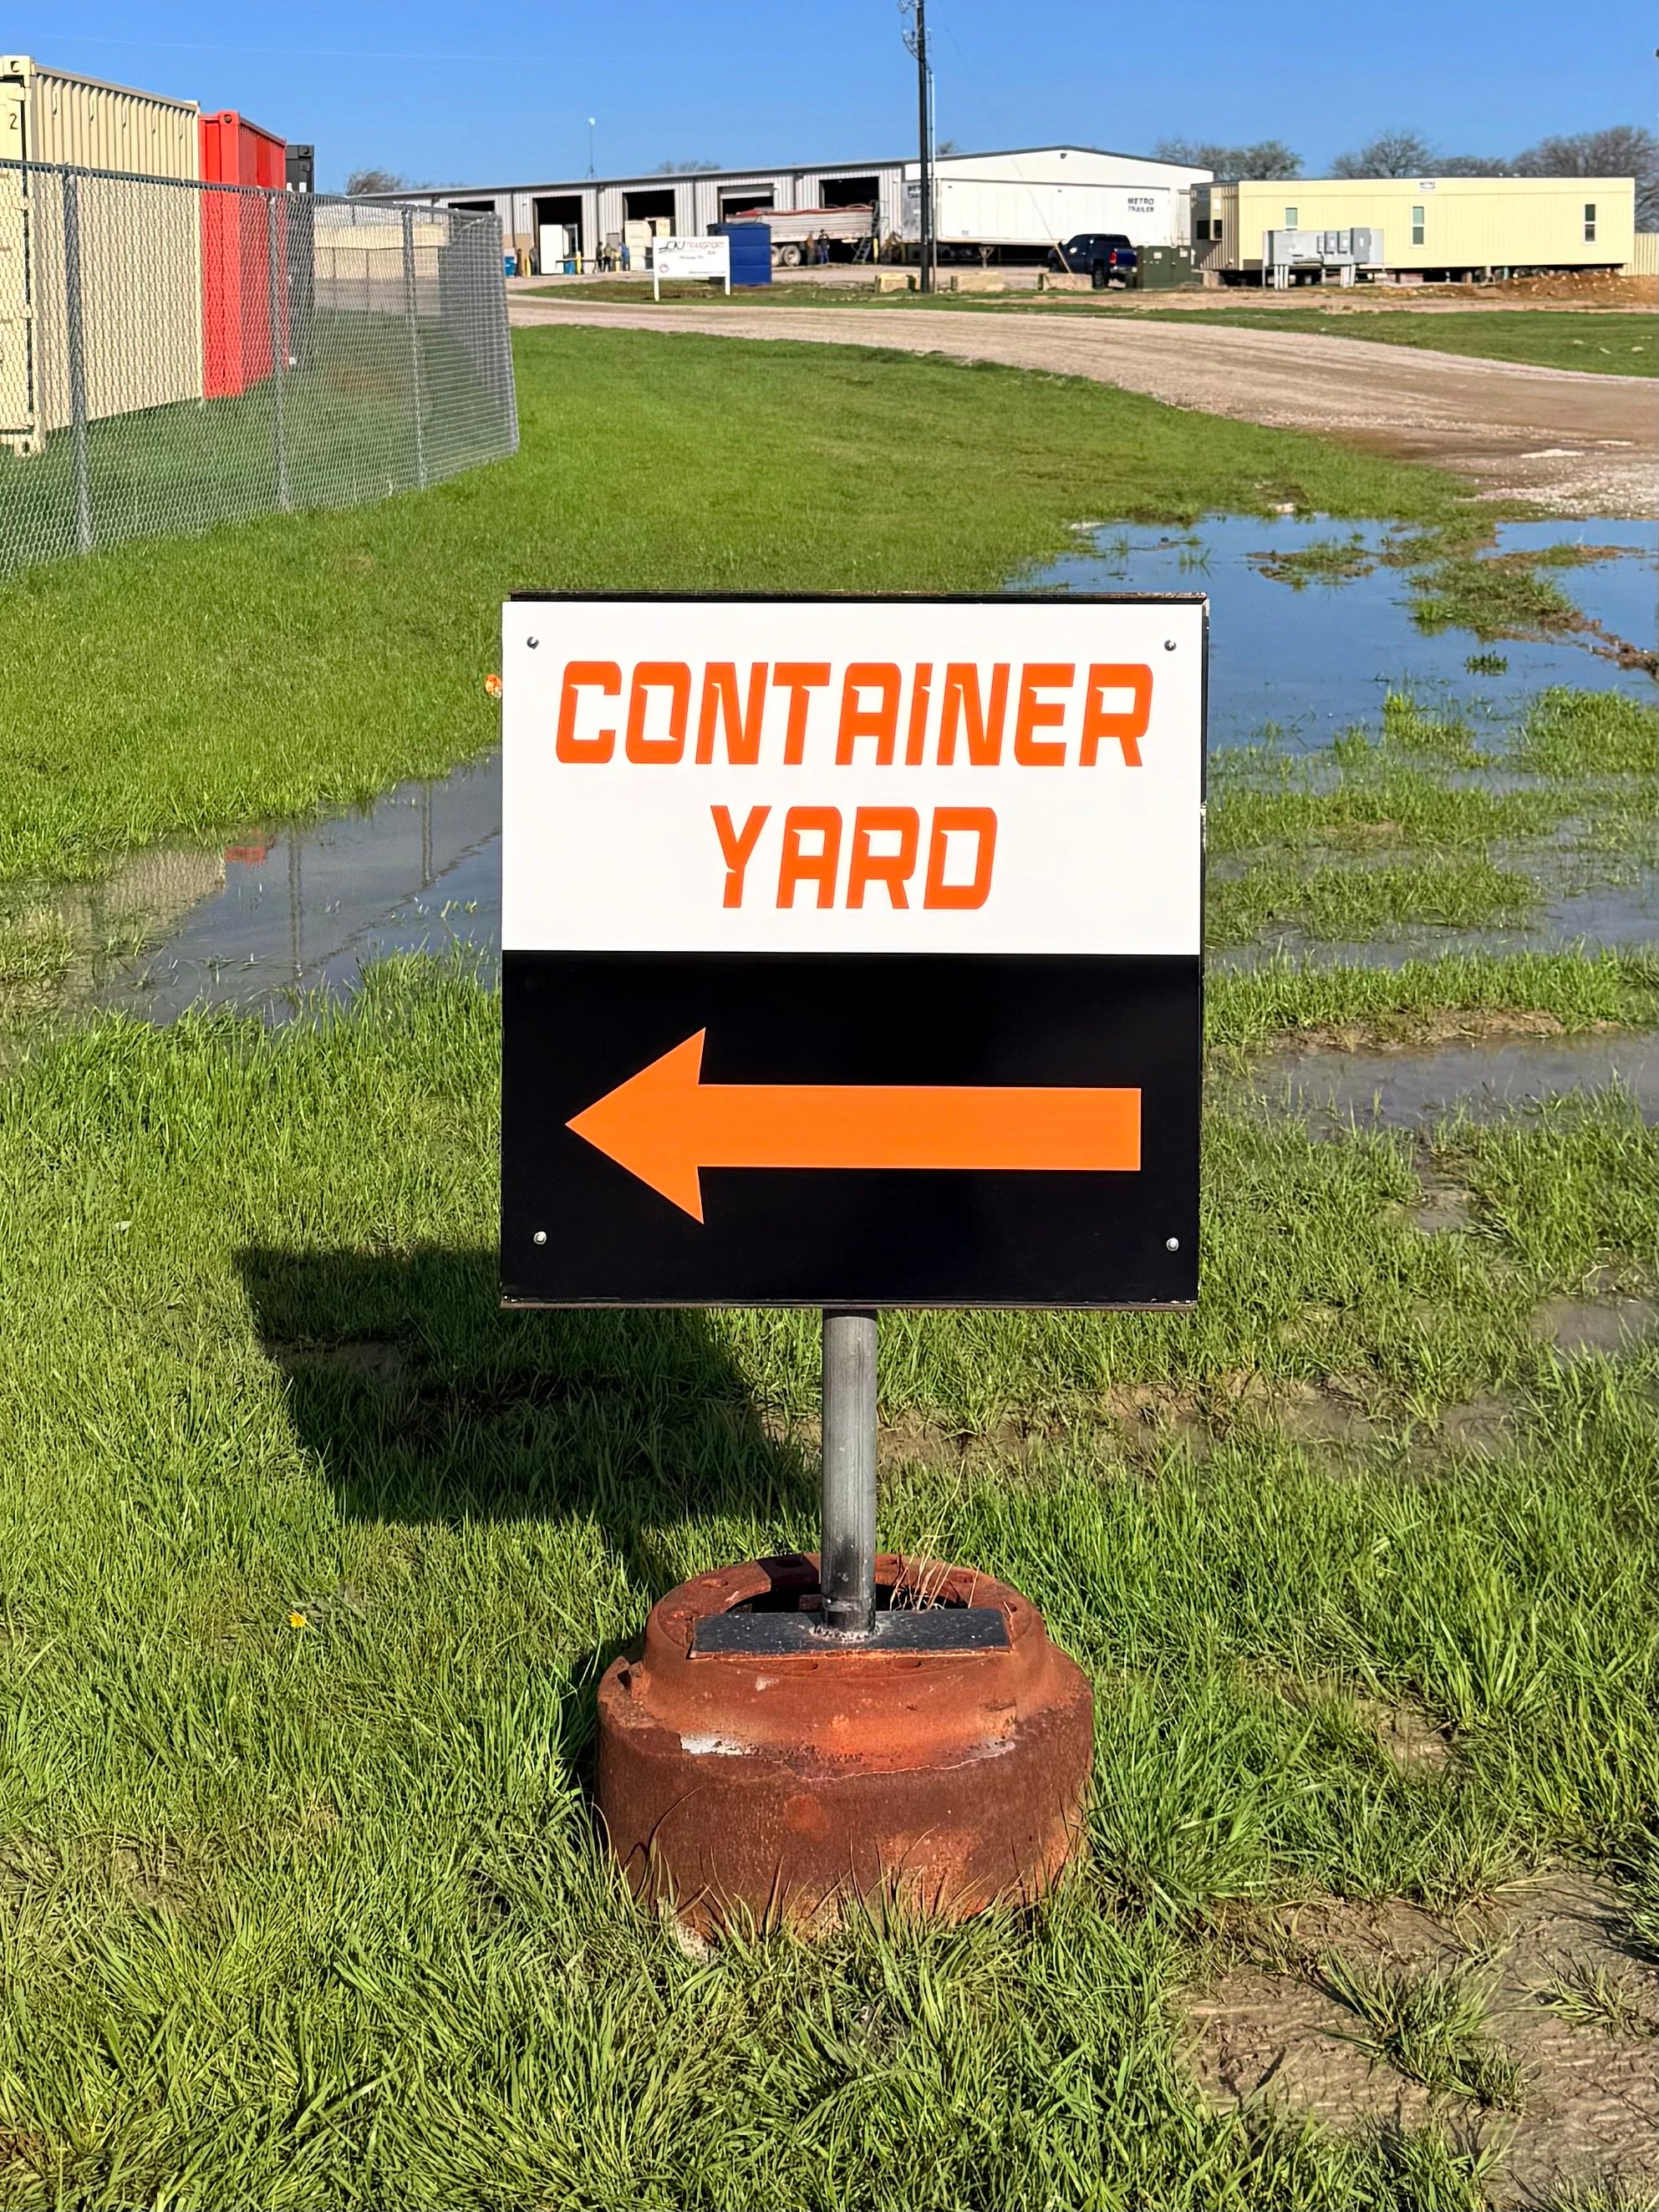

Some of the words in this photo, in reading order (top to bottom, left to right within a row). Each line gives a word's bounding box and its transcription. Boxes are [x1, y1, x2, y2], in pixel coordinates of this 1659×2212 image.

[1127, 197, 1154, 206] METRO
[556, 661, 1153, 766] CONTAINER
[711, 806, 997, 909] YARD
